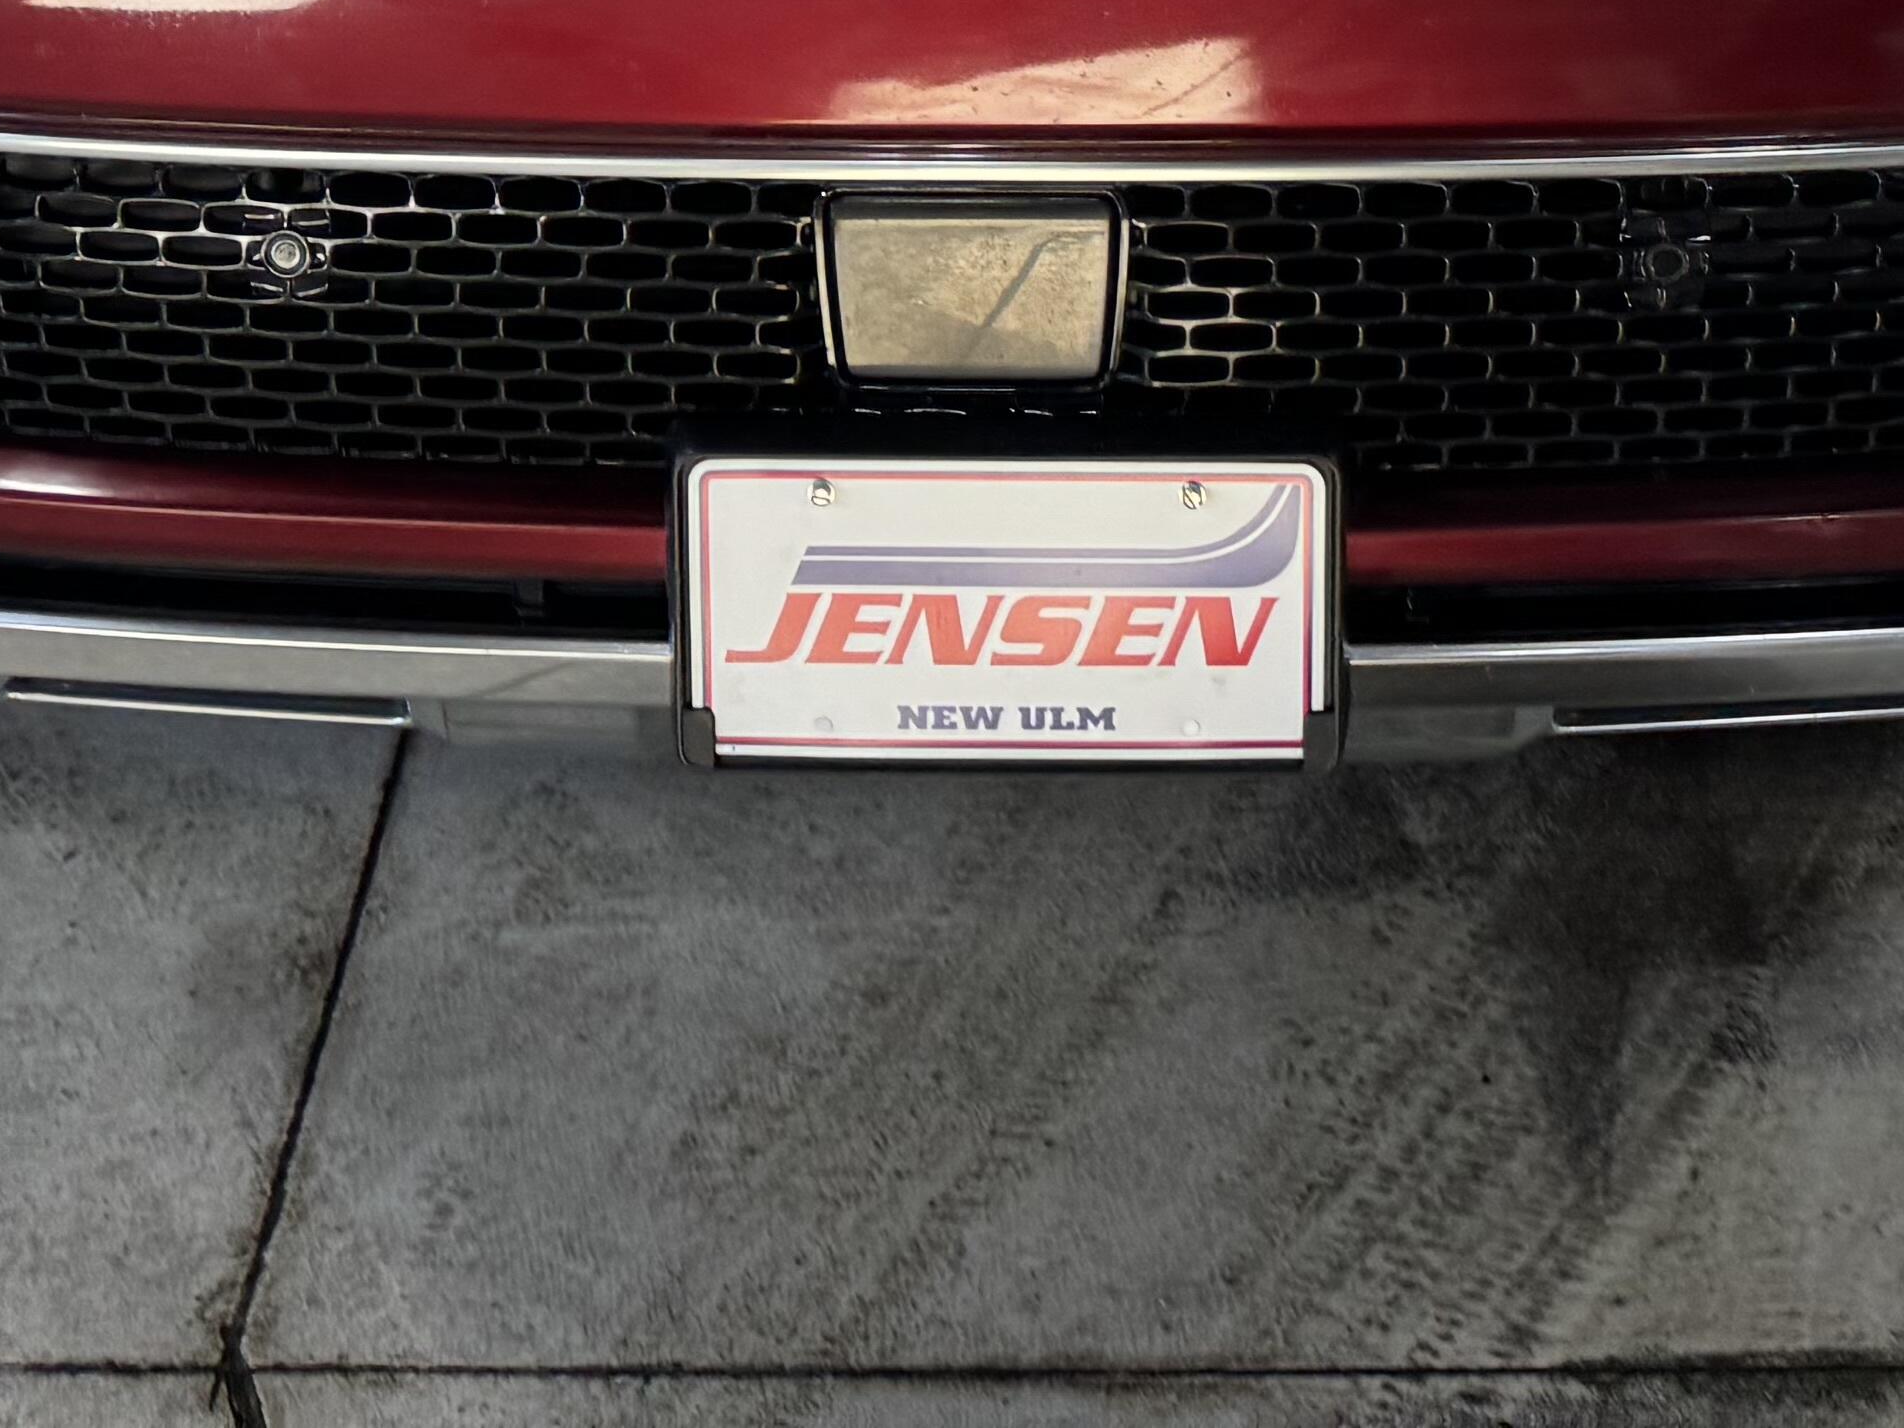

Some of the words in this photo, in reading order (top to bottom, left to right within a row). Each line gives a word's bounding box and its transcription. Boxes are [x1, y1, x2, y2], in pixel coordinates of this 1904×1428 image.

[723, 592, 1281, 668] JENSEN
[897, 704, 1004, 732] NEW
[1019, 705, 1117, 733] ULM
